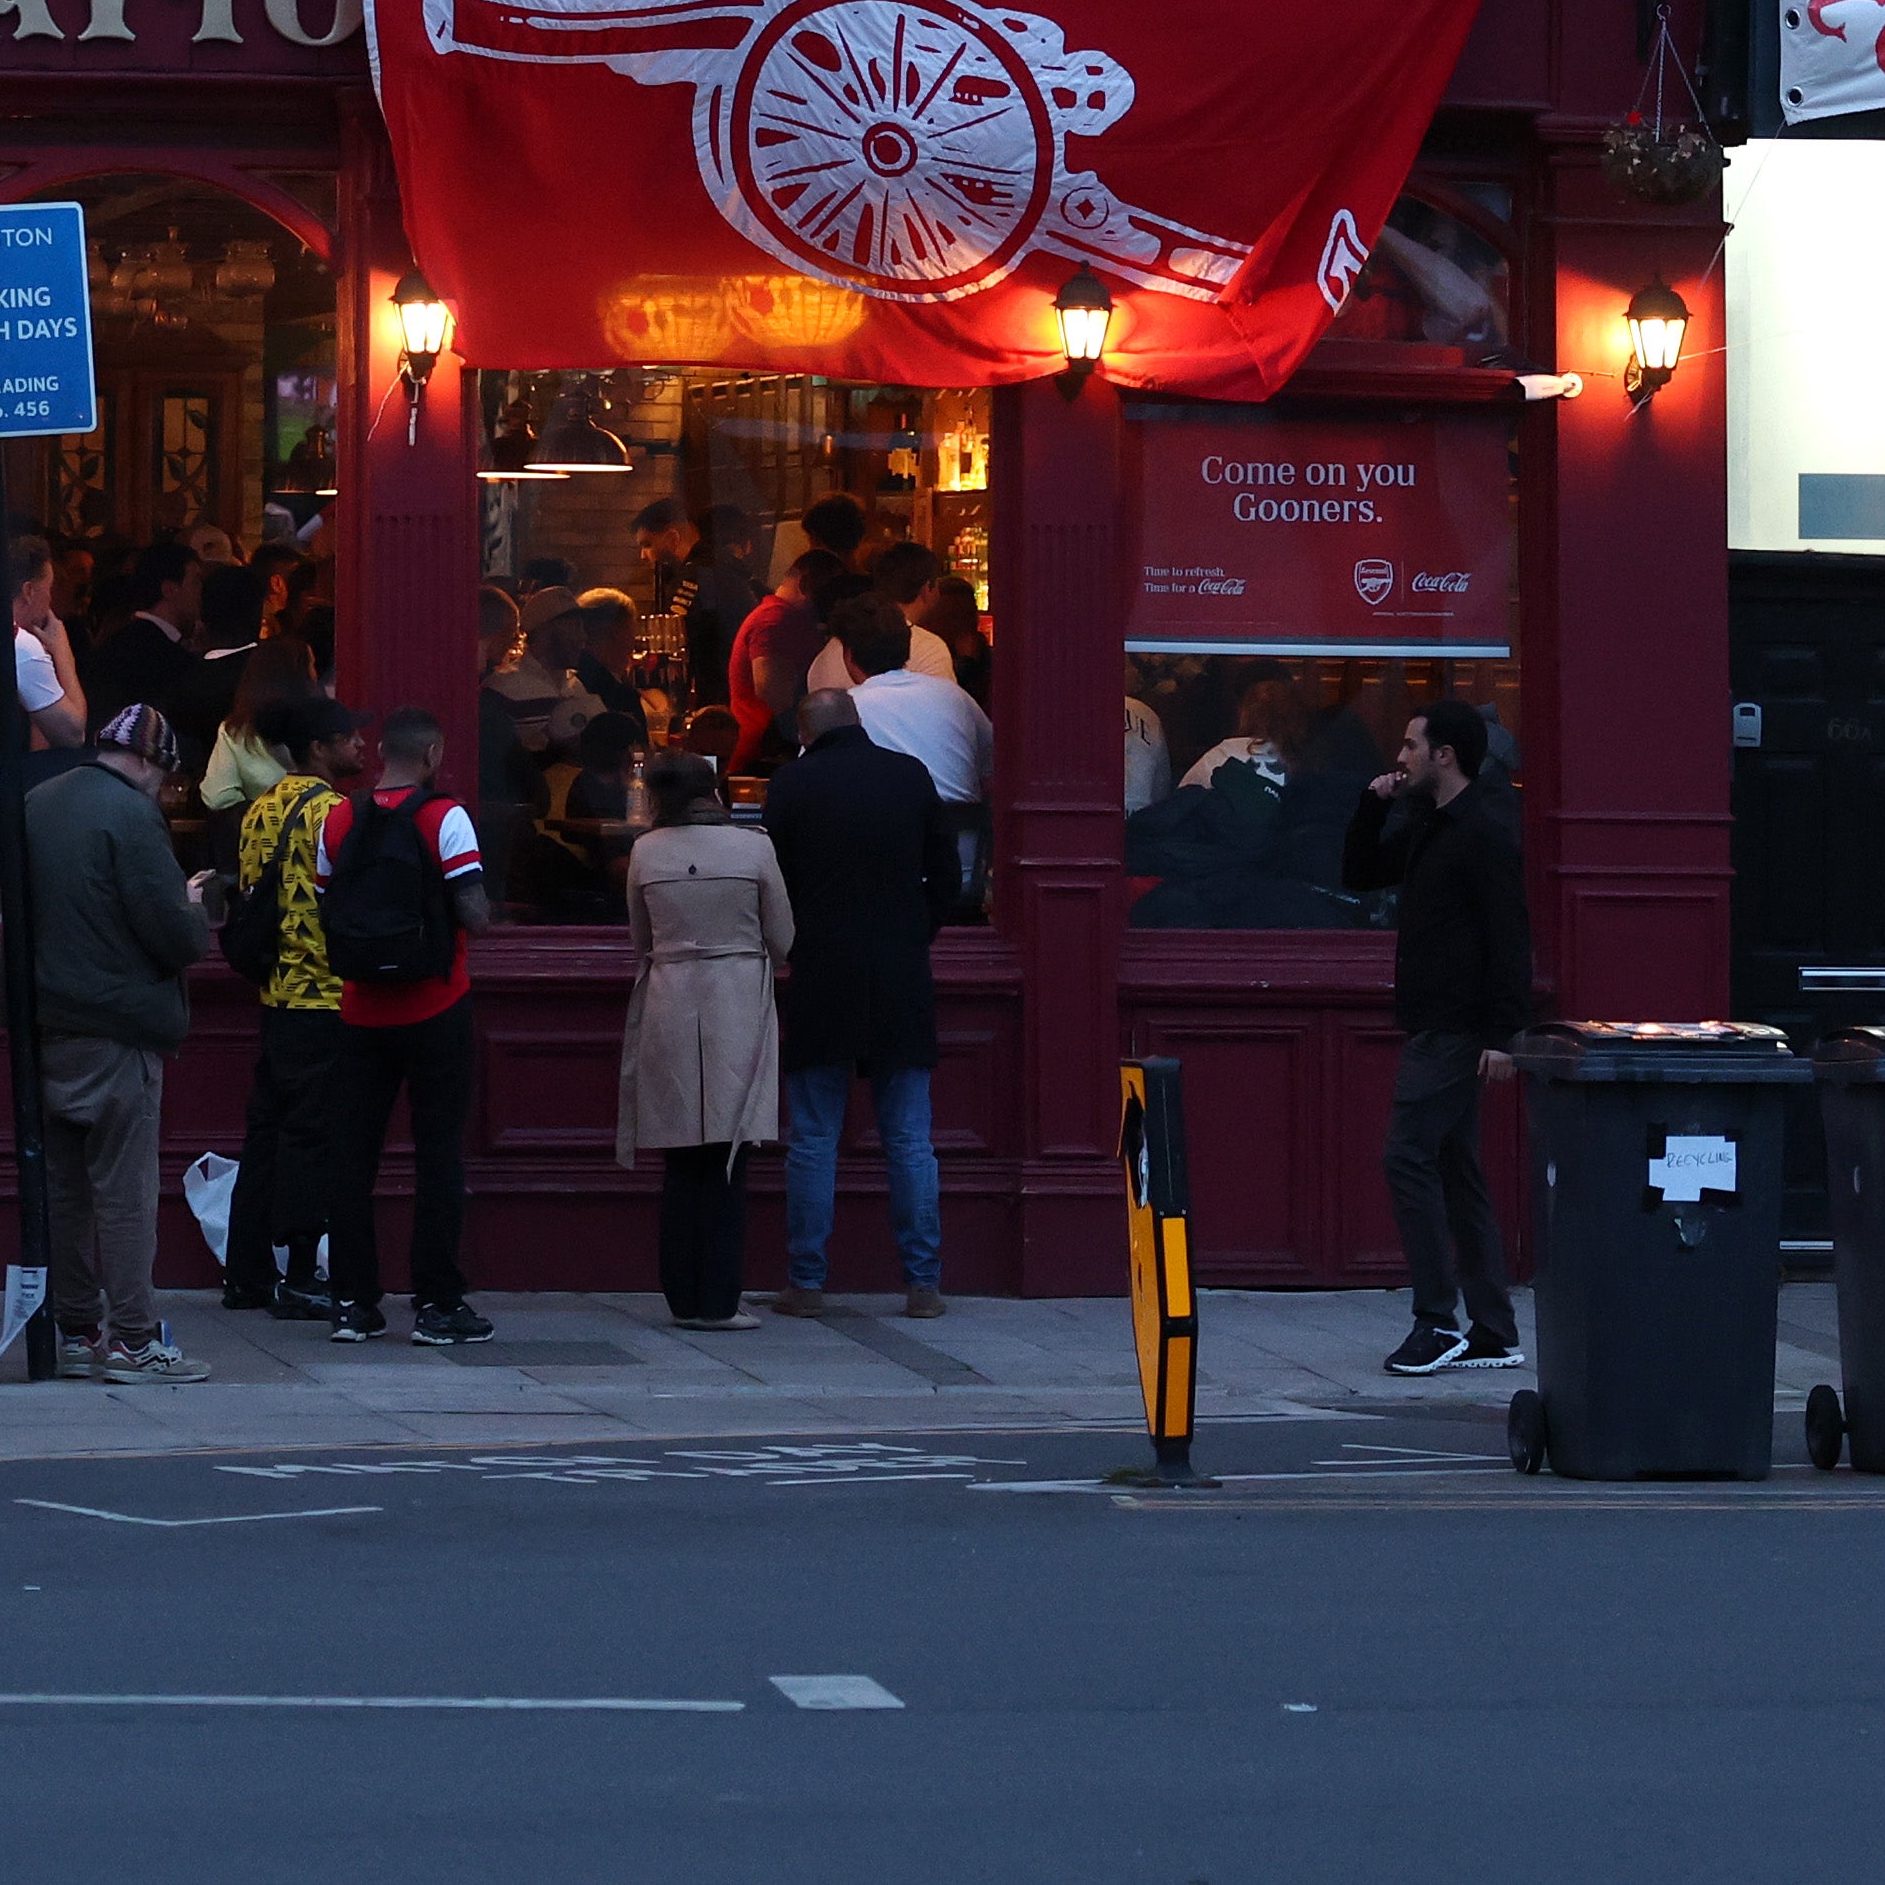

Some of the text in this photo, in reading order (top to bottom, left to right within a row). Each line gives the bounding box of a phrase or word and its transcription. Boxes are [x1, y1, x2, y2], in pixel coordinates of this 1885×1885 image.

[17, 317, 78, 340] DAYS
[14, 401, 50, 417] 456
[1201, 455, 1417, 492] Come on you
[1233, 493, 1384, 523] Gooners.
[1144, 566, 1169, 577] Time
[1172, 567, 1183, 577] to
[1144, 582, 1169, 593] Time
[1171, 582, 1187, 593] for
[1667, 1151, 1733, 1168] RECYCLING
[213, 1442, 925, 1478] MATCH DAY
